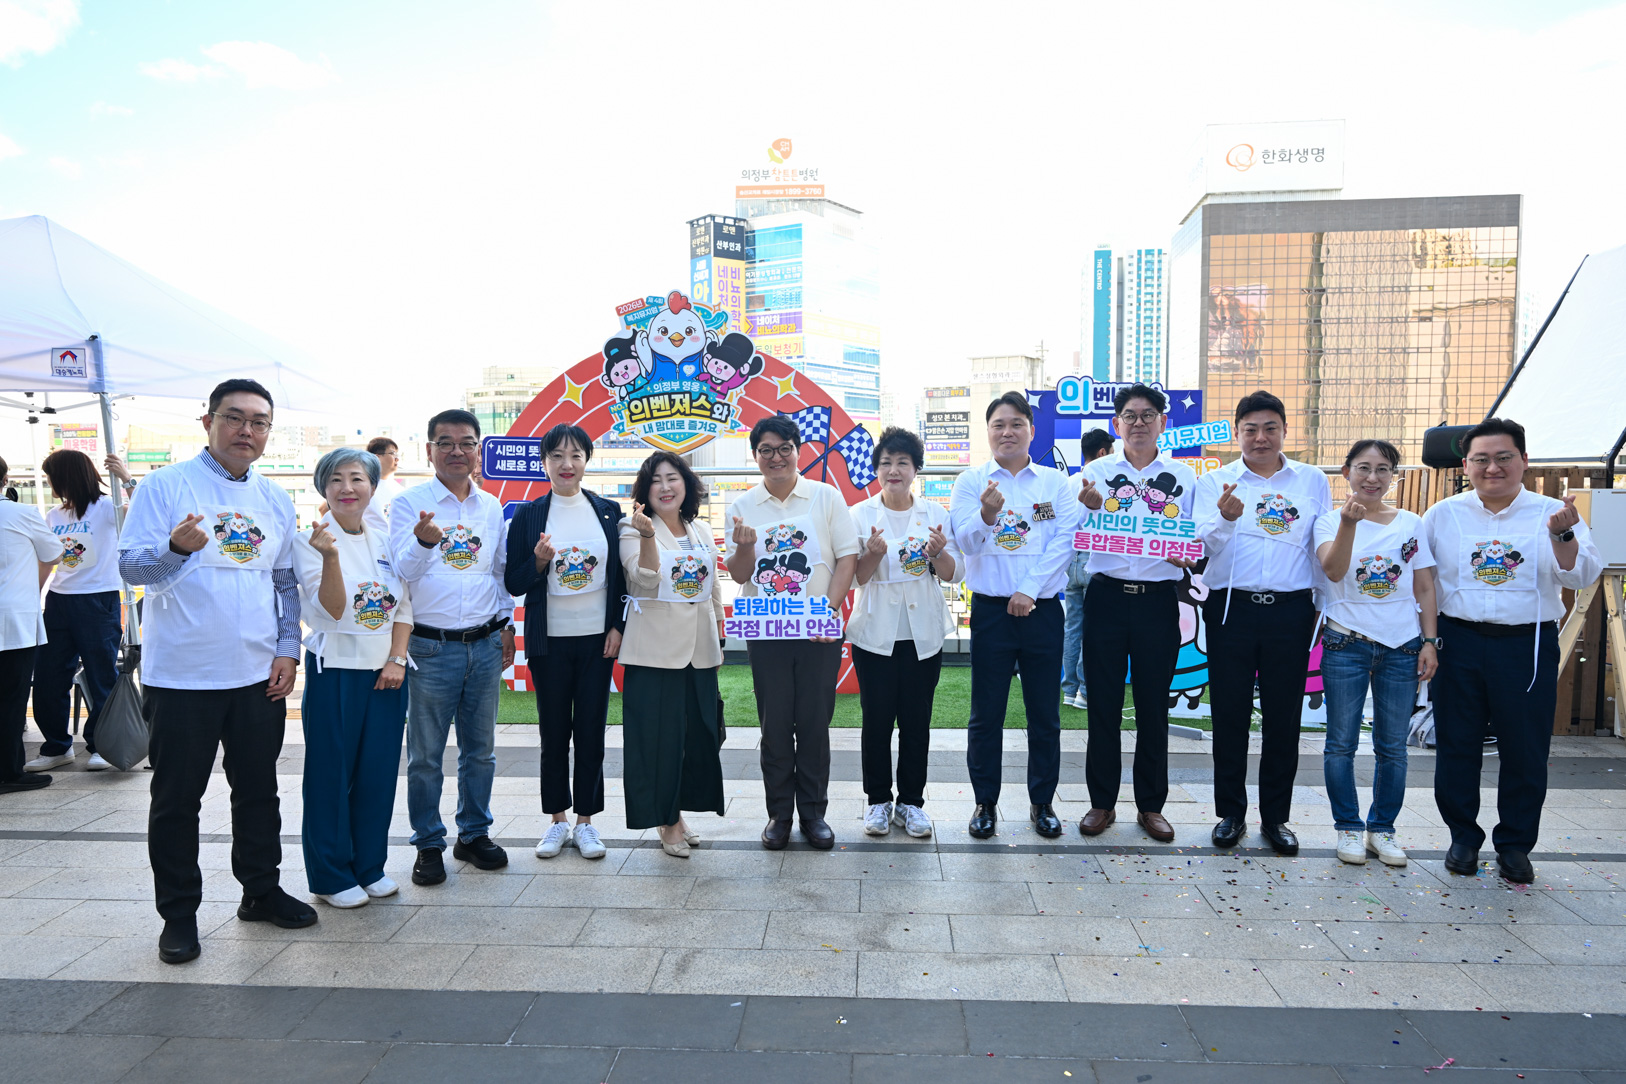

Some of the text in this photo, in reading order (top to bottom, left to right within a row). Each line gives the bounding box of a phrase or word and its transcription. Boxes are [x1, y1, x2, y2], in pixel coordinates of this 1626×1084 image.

[1261, 147, 1326, 165] 한화생명
[741, 167, 819, 183] 의정부참튼튼병원
[784, 187, 822, 196] 1899-3760
[716, 240, 741, 253] 산부인과
[716, 265, 728, 307] 네이처
[618, 299, 644, 314] 2026년
[626, 305, 659, 322] 복지뮤지엄
[757, 314, 780, 326] 네이처
[757, 322, 797, 336] 비뇨의학과
[653, 381, 700, 393] 의정부 영웅
[610, 401, 628, 413] NO.1
[629, 393, 730, 422] 의벤져스와
[643, 420, 718, 434] 내 맘대로 즐겨요
[495, 445, 541, 457] 시민의 뜻
[495, 460, 527, 472] 새로운
[1084, 512, 1196, 539] 시민의 뜻으로
[1073, 531, 1203, 561] 통합돌봄 의정부
[734, 597, 833, 616] 퇴원하는 날,
[725, 618, 841, 638] 걱정 대신 안심
